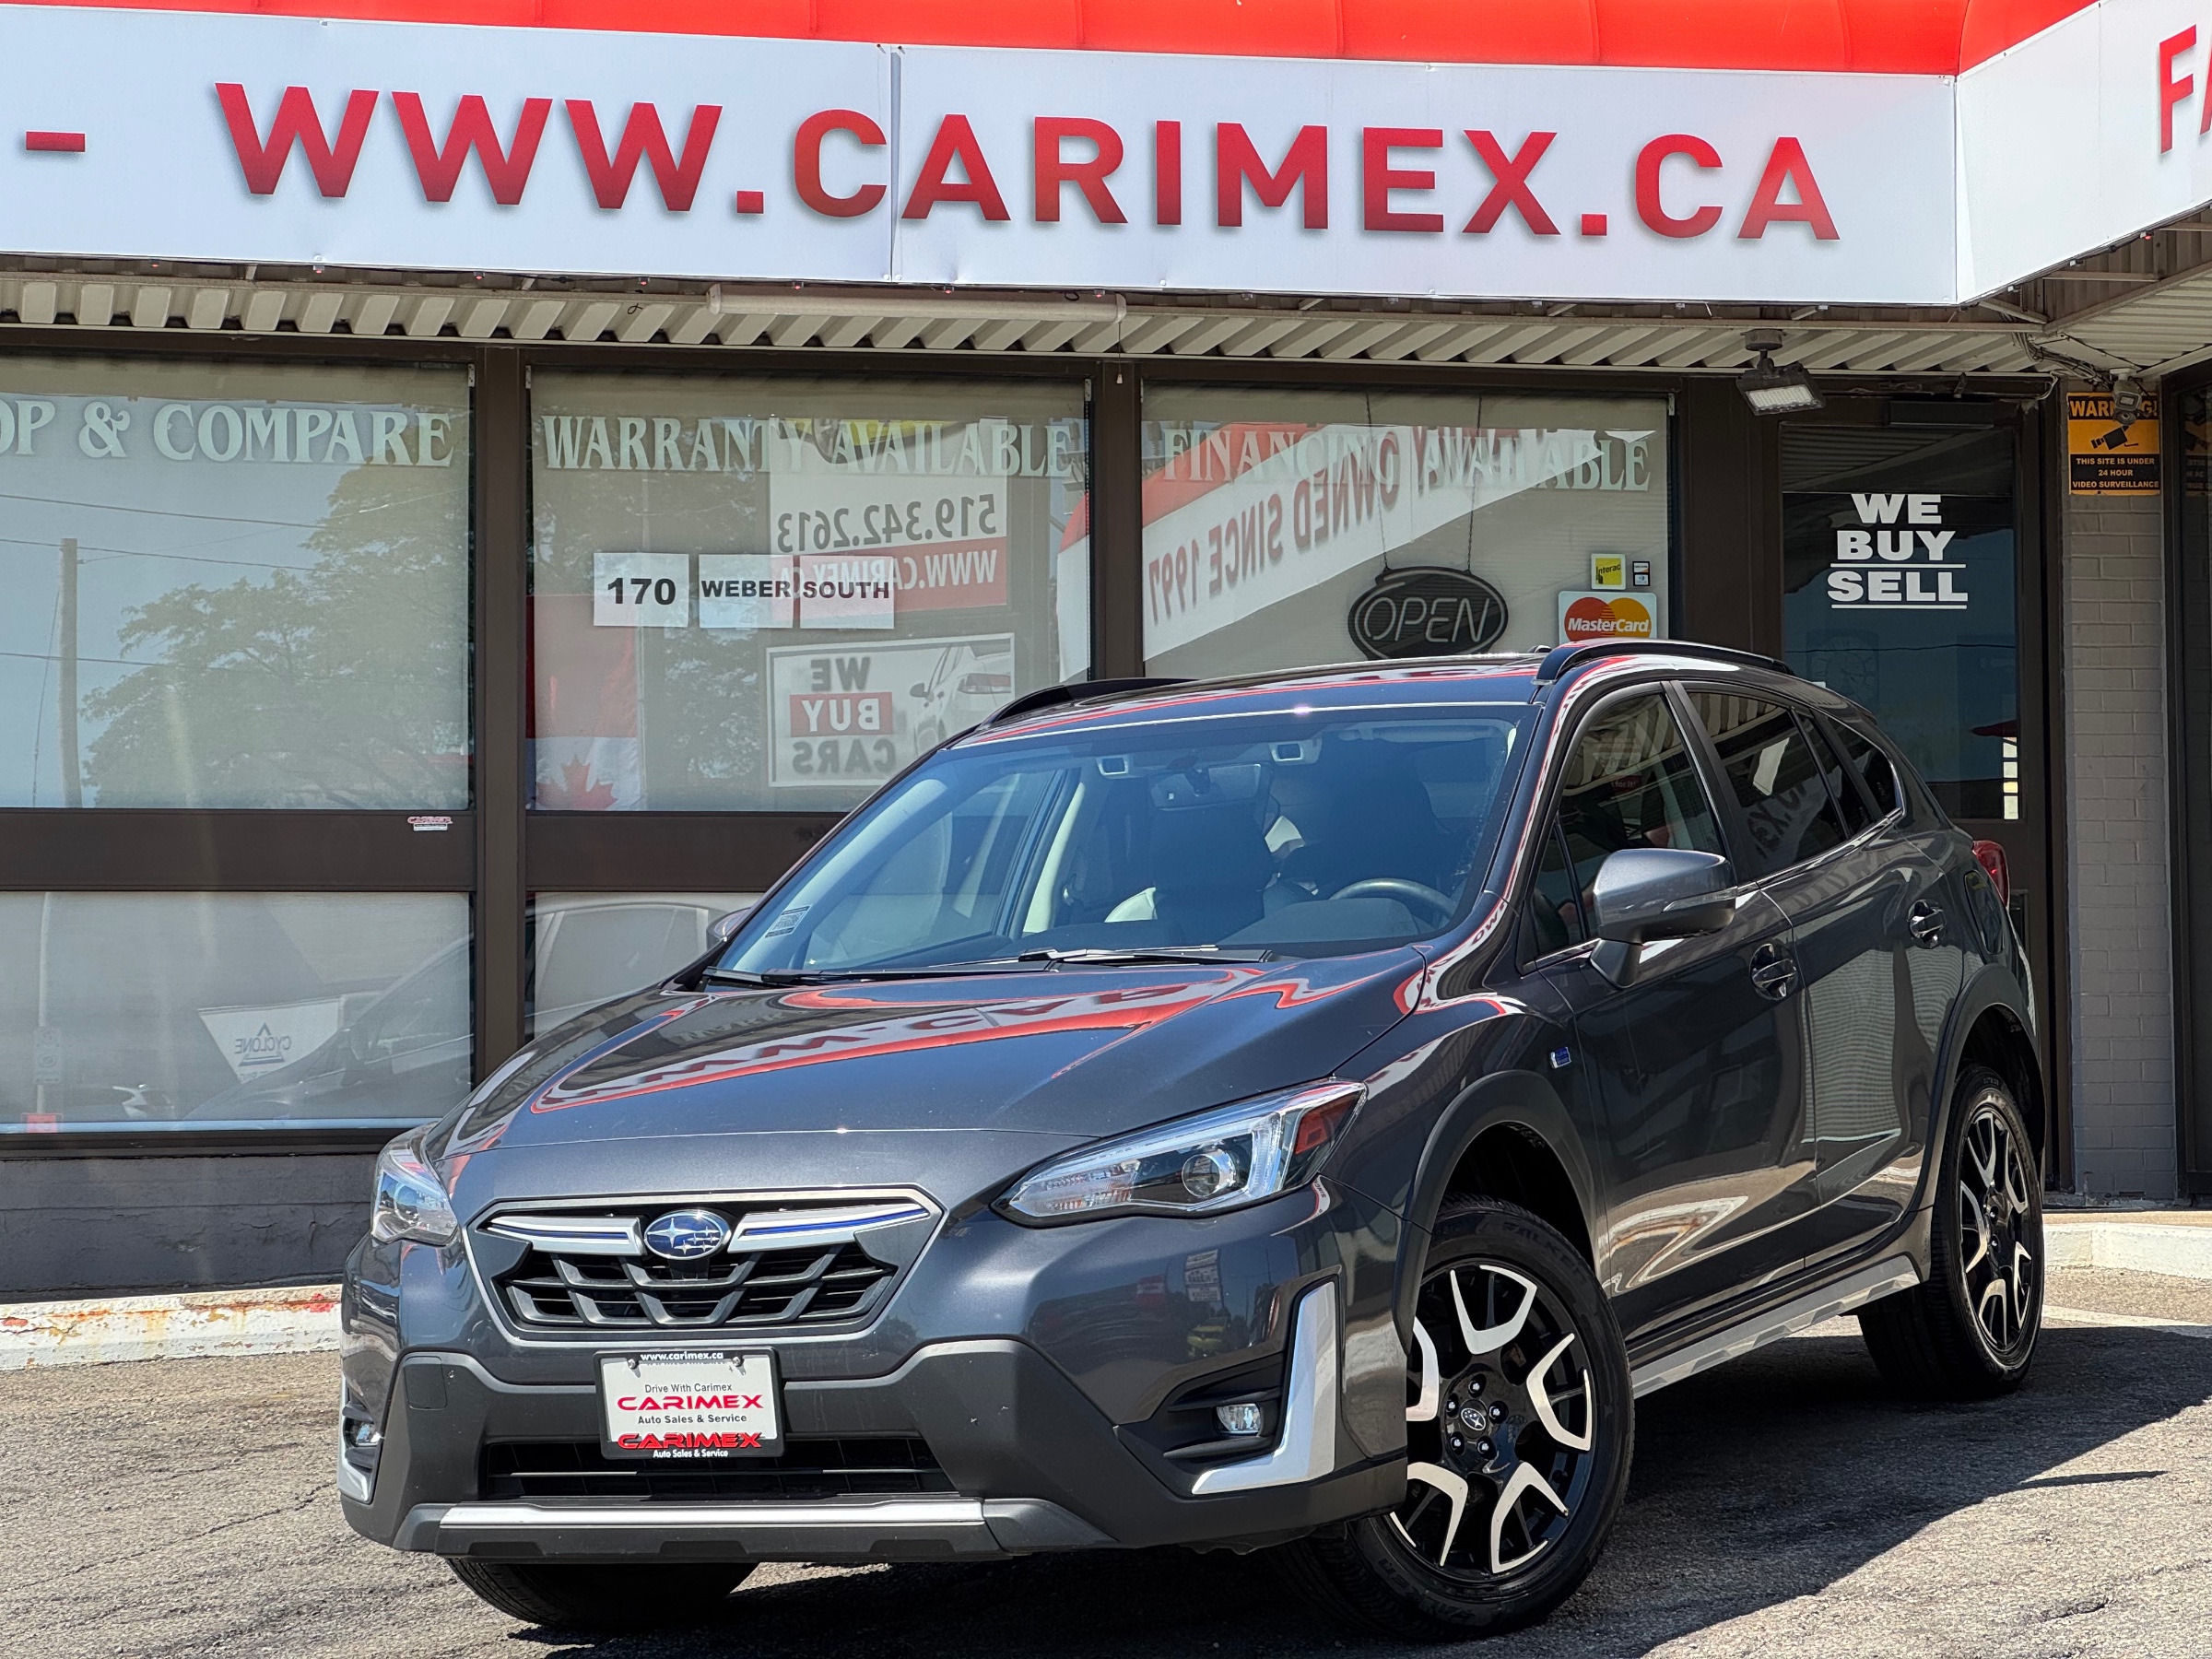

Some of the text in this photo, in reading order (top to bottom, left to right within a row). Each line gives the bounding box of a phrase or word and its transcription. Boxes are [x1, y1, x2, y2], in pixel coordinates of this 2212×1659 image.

[2159, 24, 2212, 155] F
[215, 82, 1841, 241] WWW.CARIMEX.CA
[78, 401, 131, 458] &
[153, 403, 454, 467] COMPARE
[541, 415, 1077, 477] WARRANTY AVAILABLE
[1163, 429, 1400, 486] FINANCING
[1423, 435, 1651, 492] AVAILABLE
[2076, 457, 2155, 465] THIS SITE IS UNDER
[1852, 493, 1943, 524] WE
[1837, 530, 1956, 561] BUY
[606, 577, 890, 606] 170 WEBER SOUTH
[1827, 571, 1969, 602] SELL
[1365, 596, 1490, 643] OPEN
[1568, 618, 1650, 633] MasterCard
[640, 1350, 724, 1361] www.carimex.ca
[617, 1394, 764, 1411] CARIMEX
[644, 1382, 733, 1394] Drive With Carimex
[638, 1413, 747, 1425] Auto Sales & Service
[617, 1431, 763, 1450] CARIMEX
[653, 1449, 729, 1459] Auto Sales & Service
